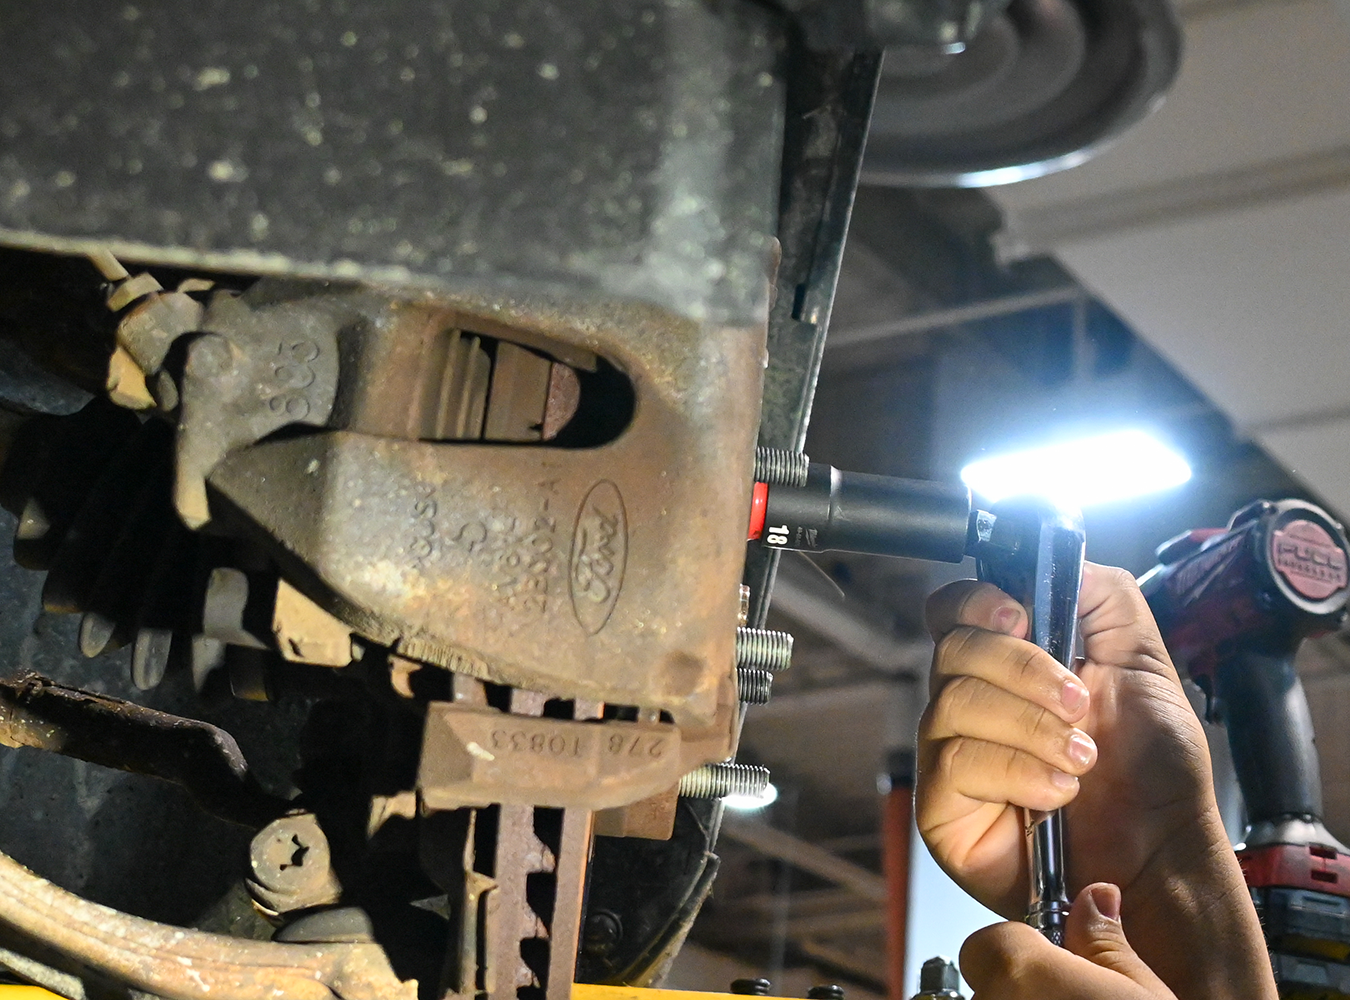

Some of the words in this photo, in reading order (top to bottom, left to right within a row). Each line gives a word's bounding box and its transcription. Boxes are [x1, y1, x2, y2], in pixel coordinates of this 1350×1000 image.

[767, 525, 790, 545] 18
[573, 502, 621, 605] Ford
[491, 729, 581, 757] 10833
[609, 733, 665, 759] 278
